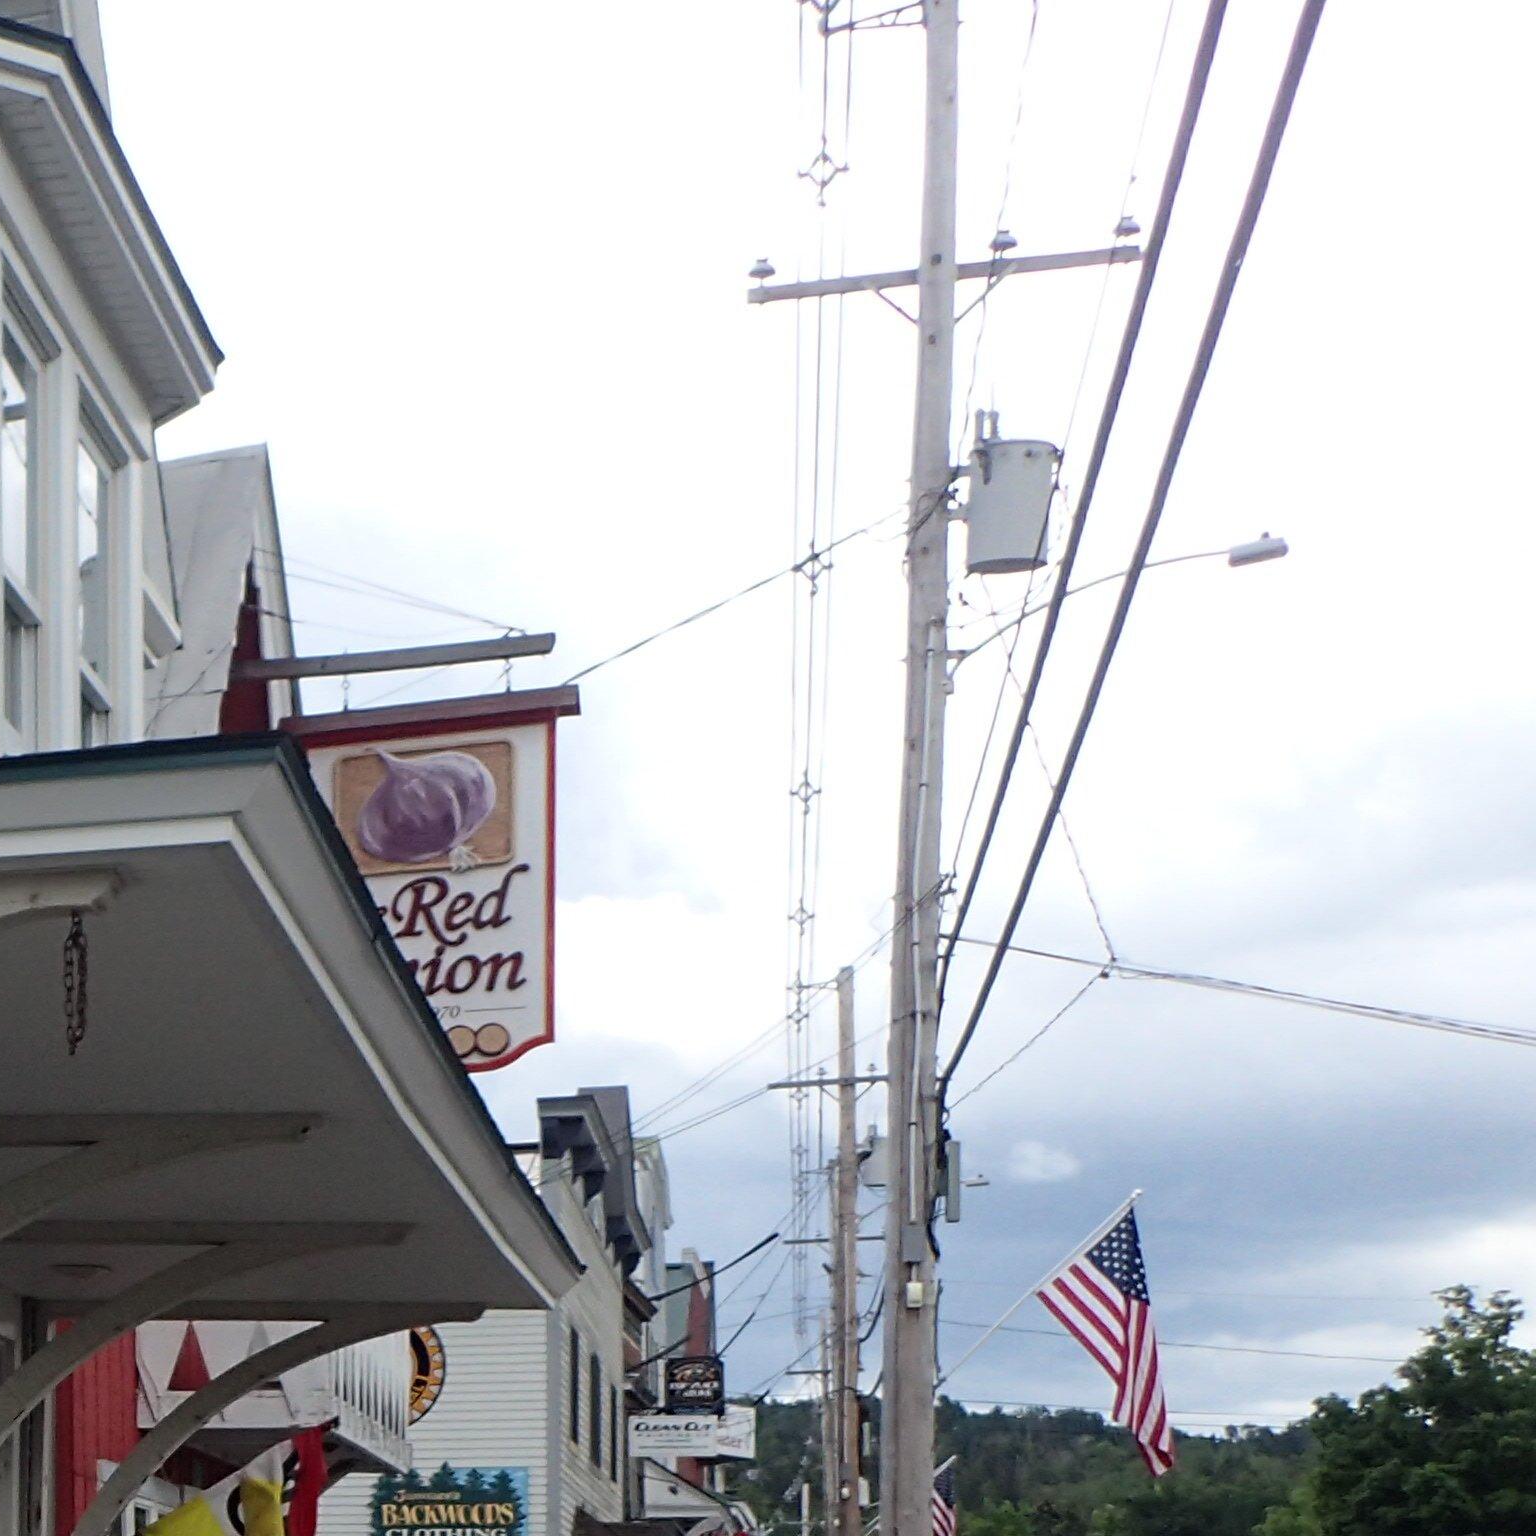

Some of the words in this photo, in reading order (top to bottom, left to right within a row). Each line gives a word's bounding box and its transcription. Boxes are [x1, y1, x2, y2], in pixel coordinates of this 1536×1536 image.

[391, 864, 530, 946] Red
[410, 948, 526, 998] ion
[381, 1503, 514, 1527] BACKWOODS
